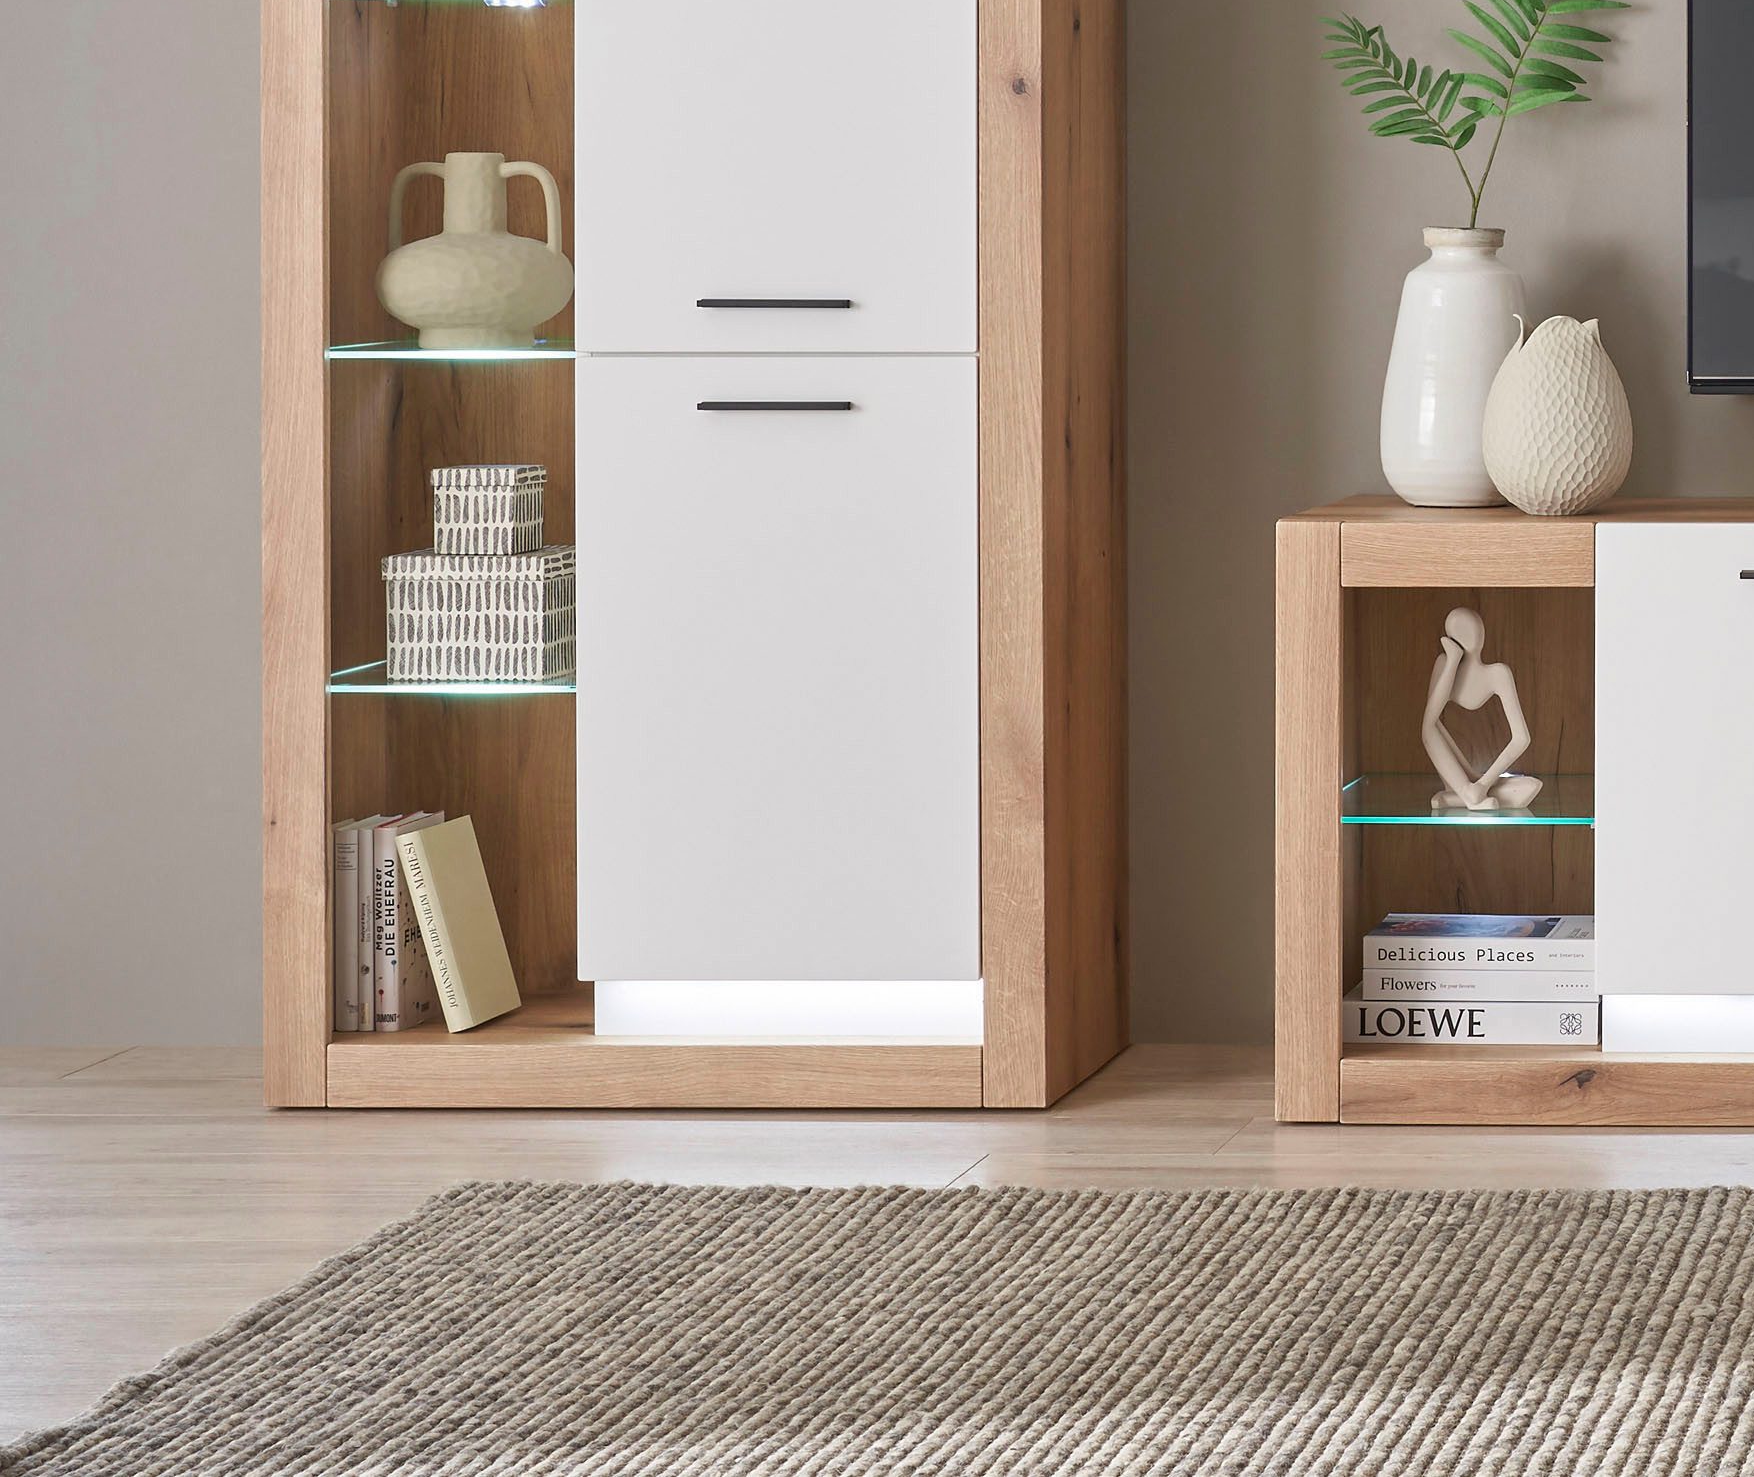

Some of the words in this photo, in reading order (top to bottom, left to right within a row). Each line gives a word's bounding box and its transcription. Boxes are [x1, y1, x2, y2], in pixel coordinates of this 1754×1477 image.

[403, 842, 426, 890] MARESI
[384, 859, 395, 927] EHEFRAU
[376, 926, 384, 951] Meg
[419, 894, 443, 957] WEIDENHEIM
[385, 932, 395, 956] DIE
[1378, 948, 1466, 962] Delicious
[1476, 948, 1535, 962] Places
[439, 959, 459, 1008] JOHANNES
[1381, 977, 1437, 991] Flowers
[1358, 1007, 1485, 1038] LOEWE
